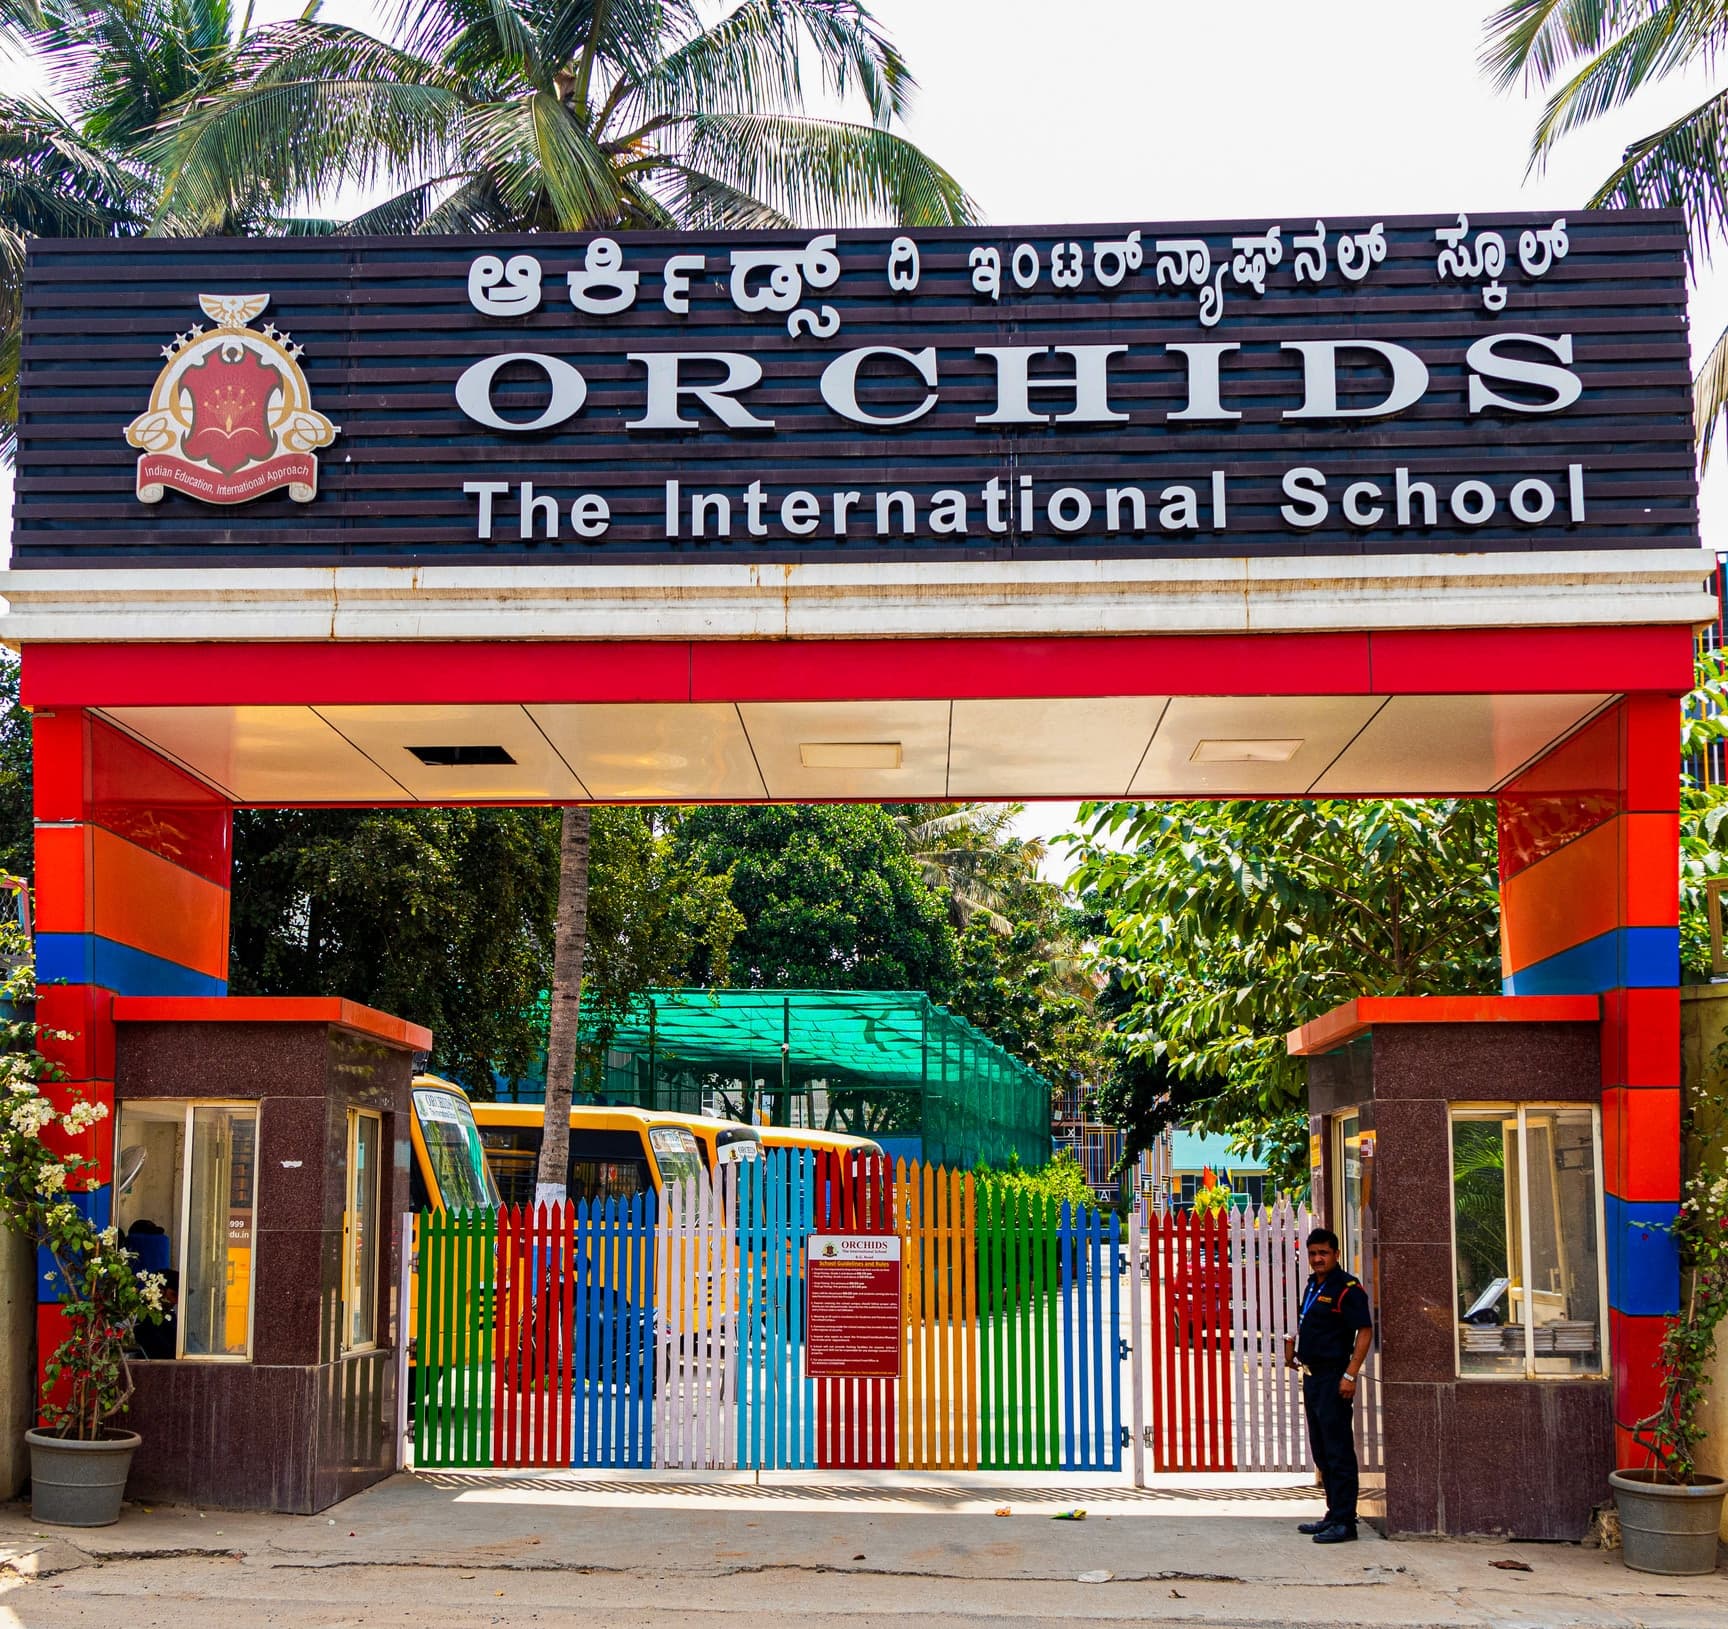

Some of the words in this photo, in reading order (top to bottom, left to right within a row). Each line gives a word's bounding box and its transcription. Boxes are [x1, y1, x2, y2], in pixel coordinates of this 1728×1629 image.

[467, 233, 841, 339] ಆರ್ಕಿಡ್ಸ್
[887, 236, 920, 291] ದಿ
[1435, 213, 1570, 311] ಸ್ಕೂಲ್
[455, 331, 1583, 431] ORCHIDS
[144, 465, 173, 478] Indian
[174, 469, 214, 494] Education,
[217, 474, 266, 496] International
[267, 465, 309, 483] Approach
[463, 480, 610, 539] The
[666, 470, 1226, 538] International
[1281, 464, 1585, 528] School
[841, 1240, 888, 1249] ORCHIDS
